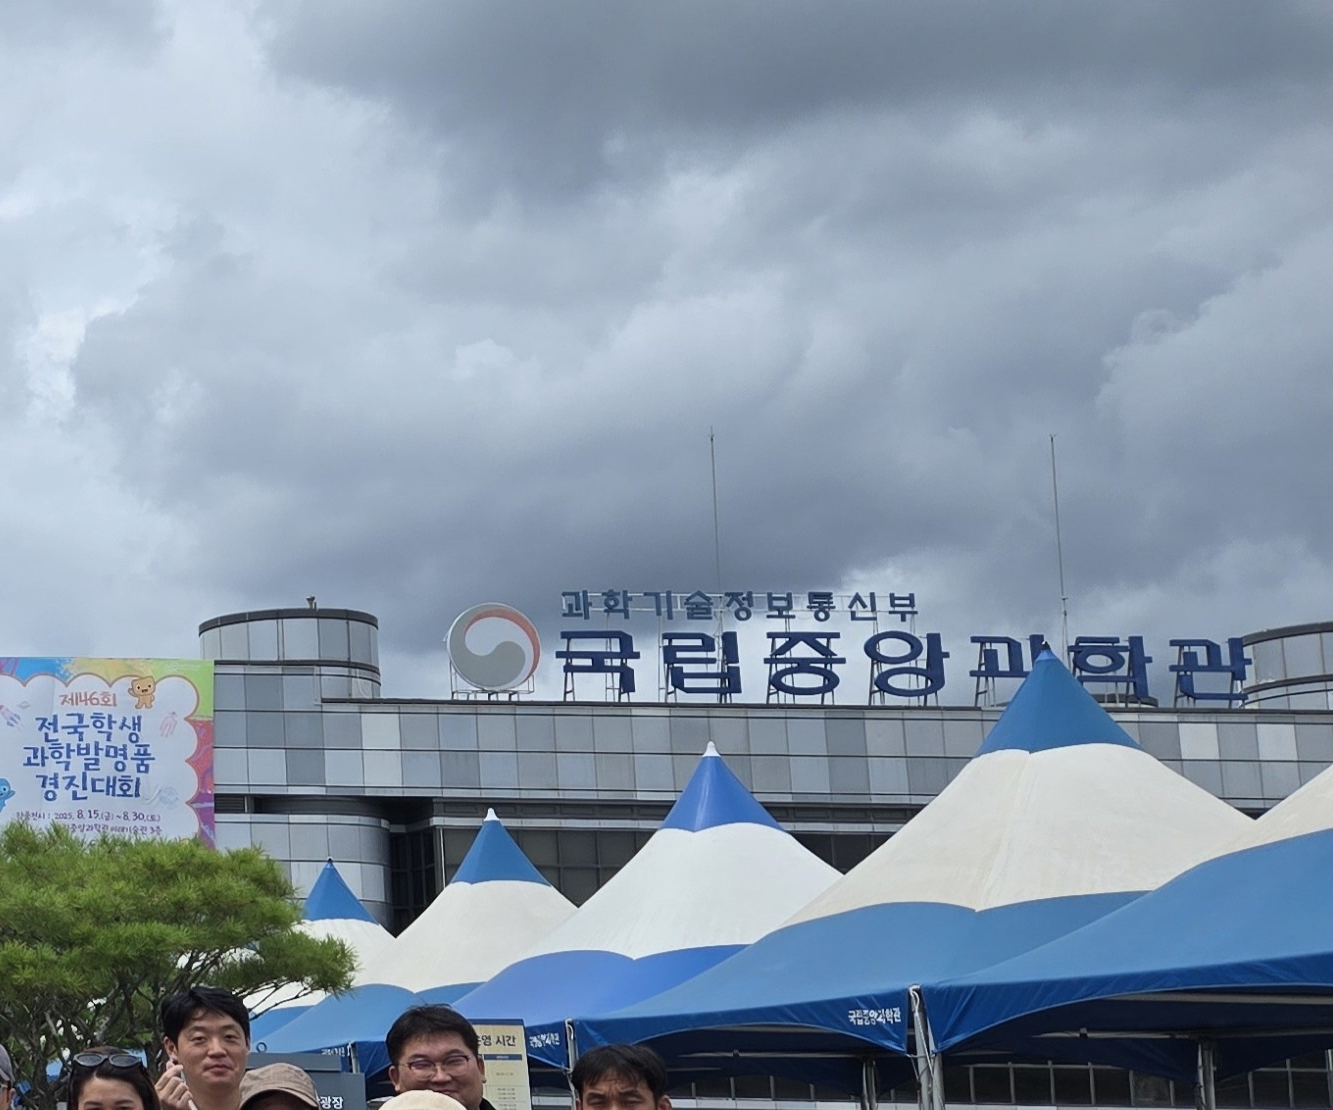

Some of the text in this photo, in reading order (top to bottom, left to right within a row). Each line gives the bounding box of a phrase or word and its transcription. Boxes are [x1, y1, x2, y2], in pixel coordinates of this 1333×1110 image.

[560, 588, 919, 622] 과학기술정보통신부
[555, 630, 1253, 701] 국립중앙과학관
[59, 692, 117, 708] 제46회
[36, 712, 142, 743] 전국학생
[23, 744, 155, 773] 과학발명품
[36, 772, 141, 802] 경진대회
[495, 1035, 517, 1047] 시간
